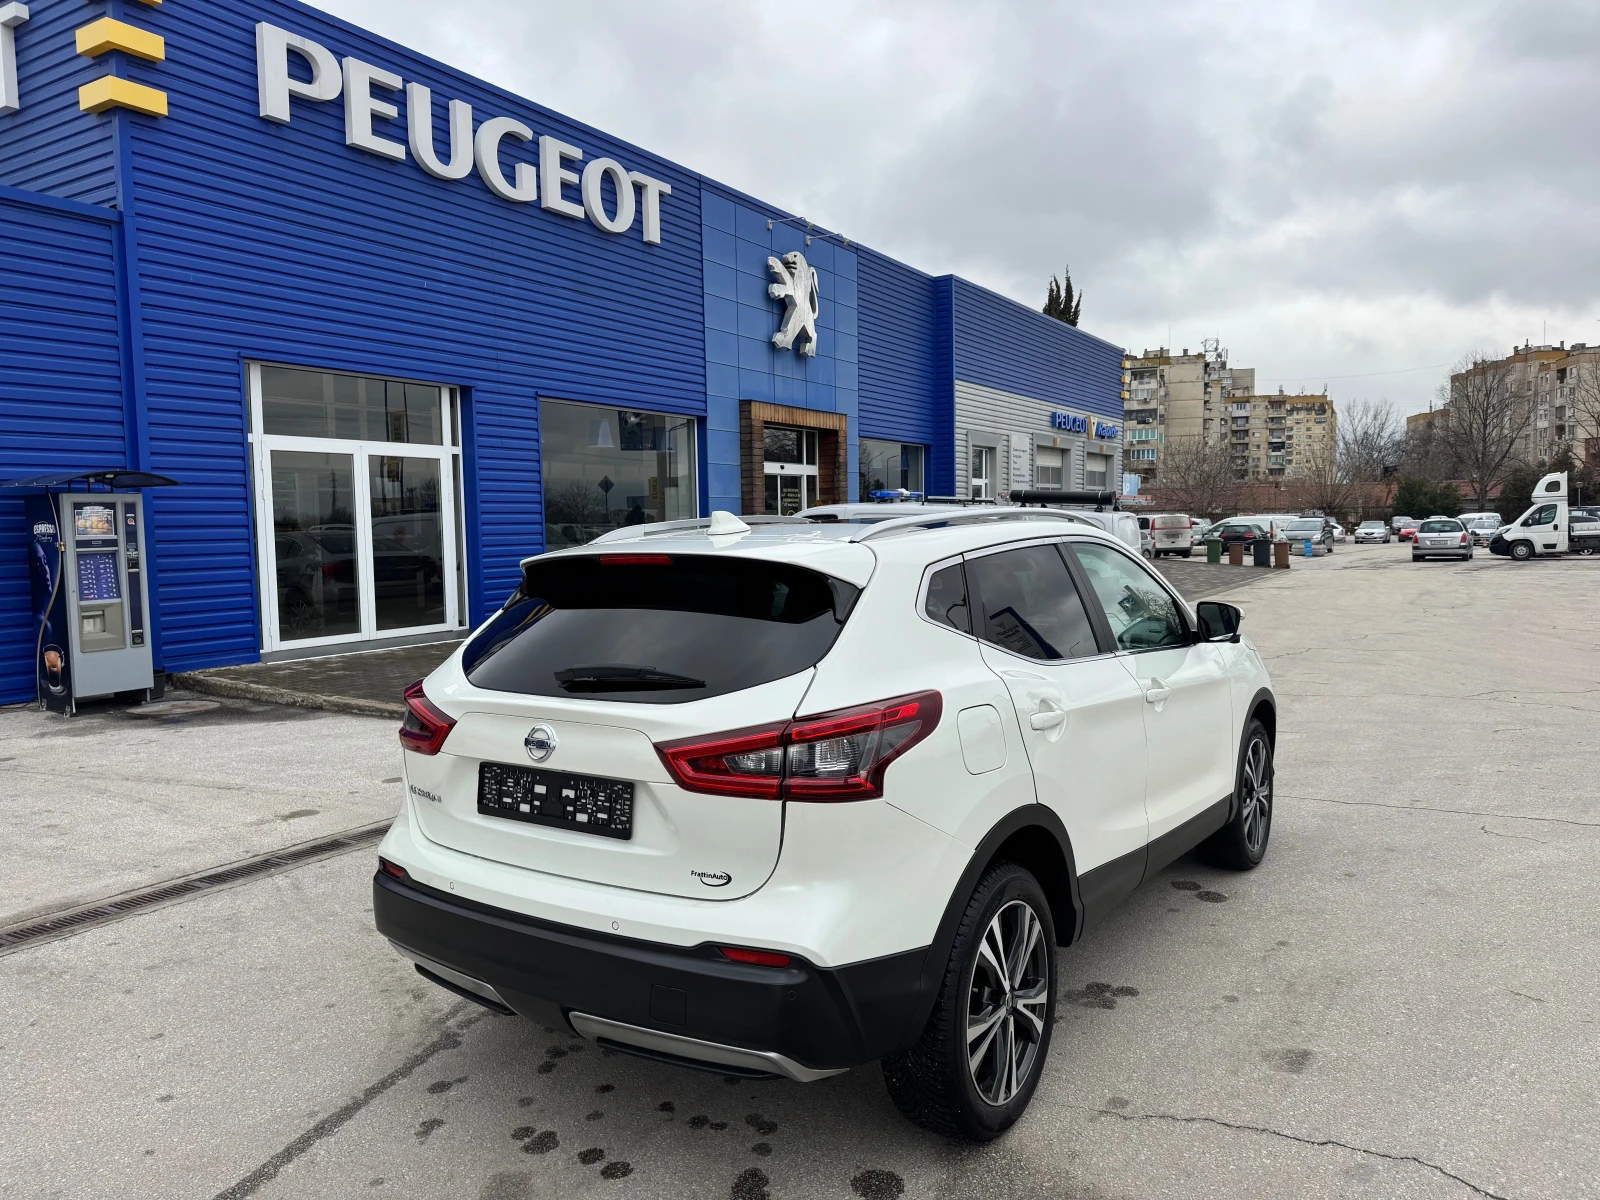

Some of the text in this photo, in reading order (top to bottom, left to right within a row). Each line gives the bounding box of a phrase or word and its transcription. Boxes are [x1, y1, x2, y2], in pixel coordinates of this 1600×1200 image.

[255, 21, 672, 244] PEUGEOT
[1053, 412, 1088, 433] PEUGEOT
[690, 870, 728, 881] FrattinAuto
